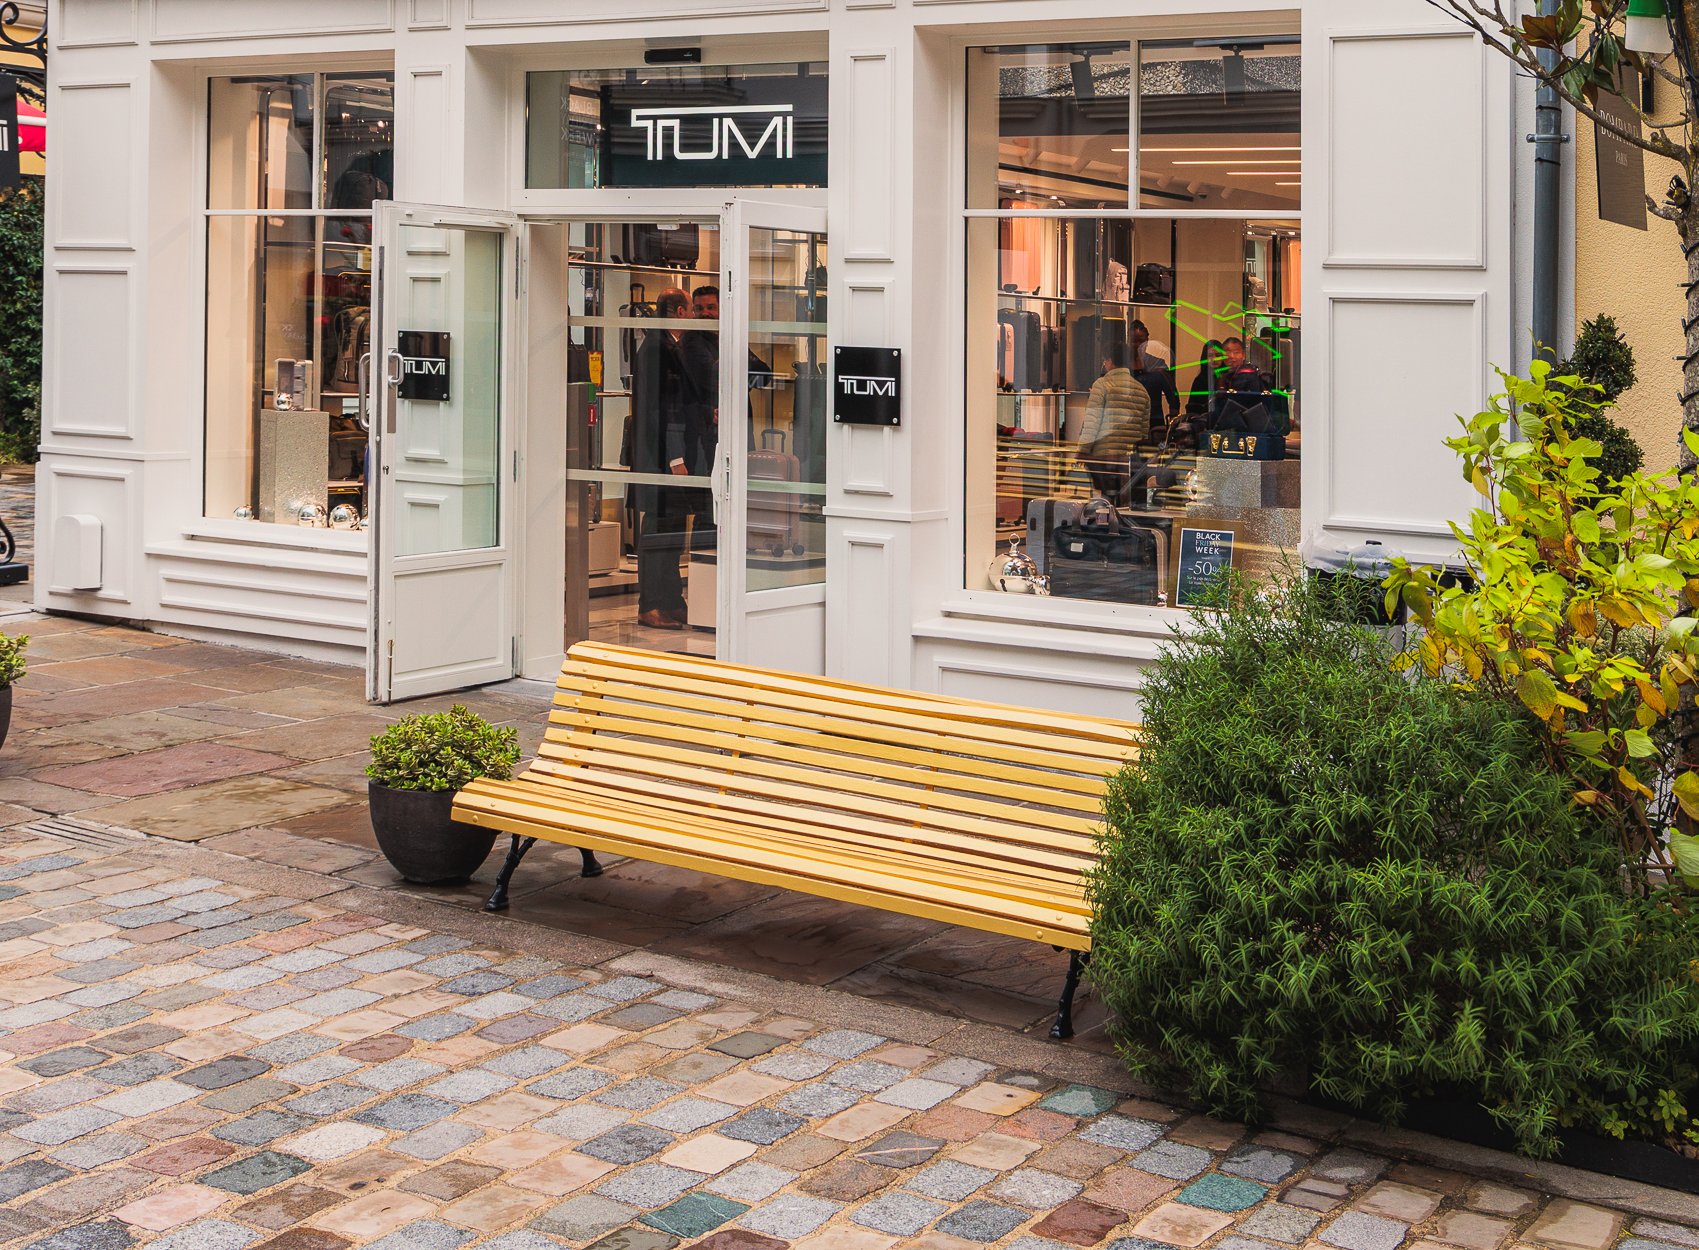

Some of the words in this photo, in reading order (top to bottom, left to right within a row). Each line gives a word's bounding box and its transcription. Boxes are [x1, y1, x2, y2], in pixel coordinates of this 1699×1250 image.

[630, 104, 793, 161] TUMI
[403, 356, 446, 376] TUMI
[838, 375, 896, 397] TUMI
[1195, 539, 1220, 547] FRIDAY
[1196, 532, 1221, 540] BLACK
[1195, 546, 1220, 554] WEEK
